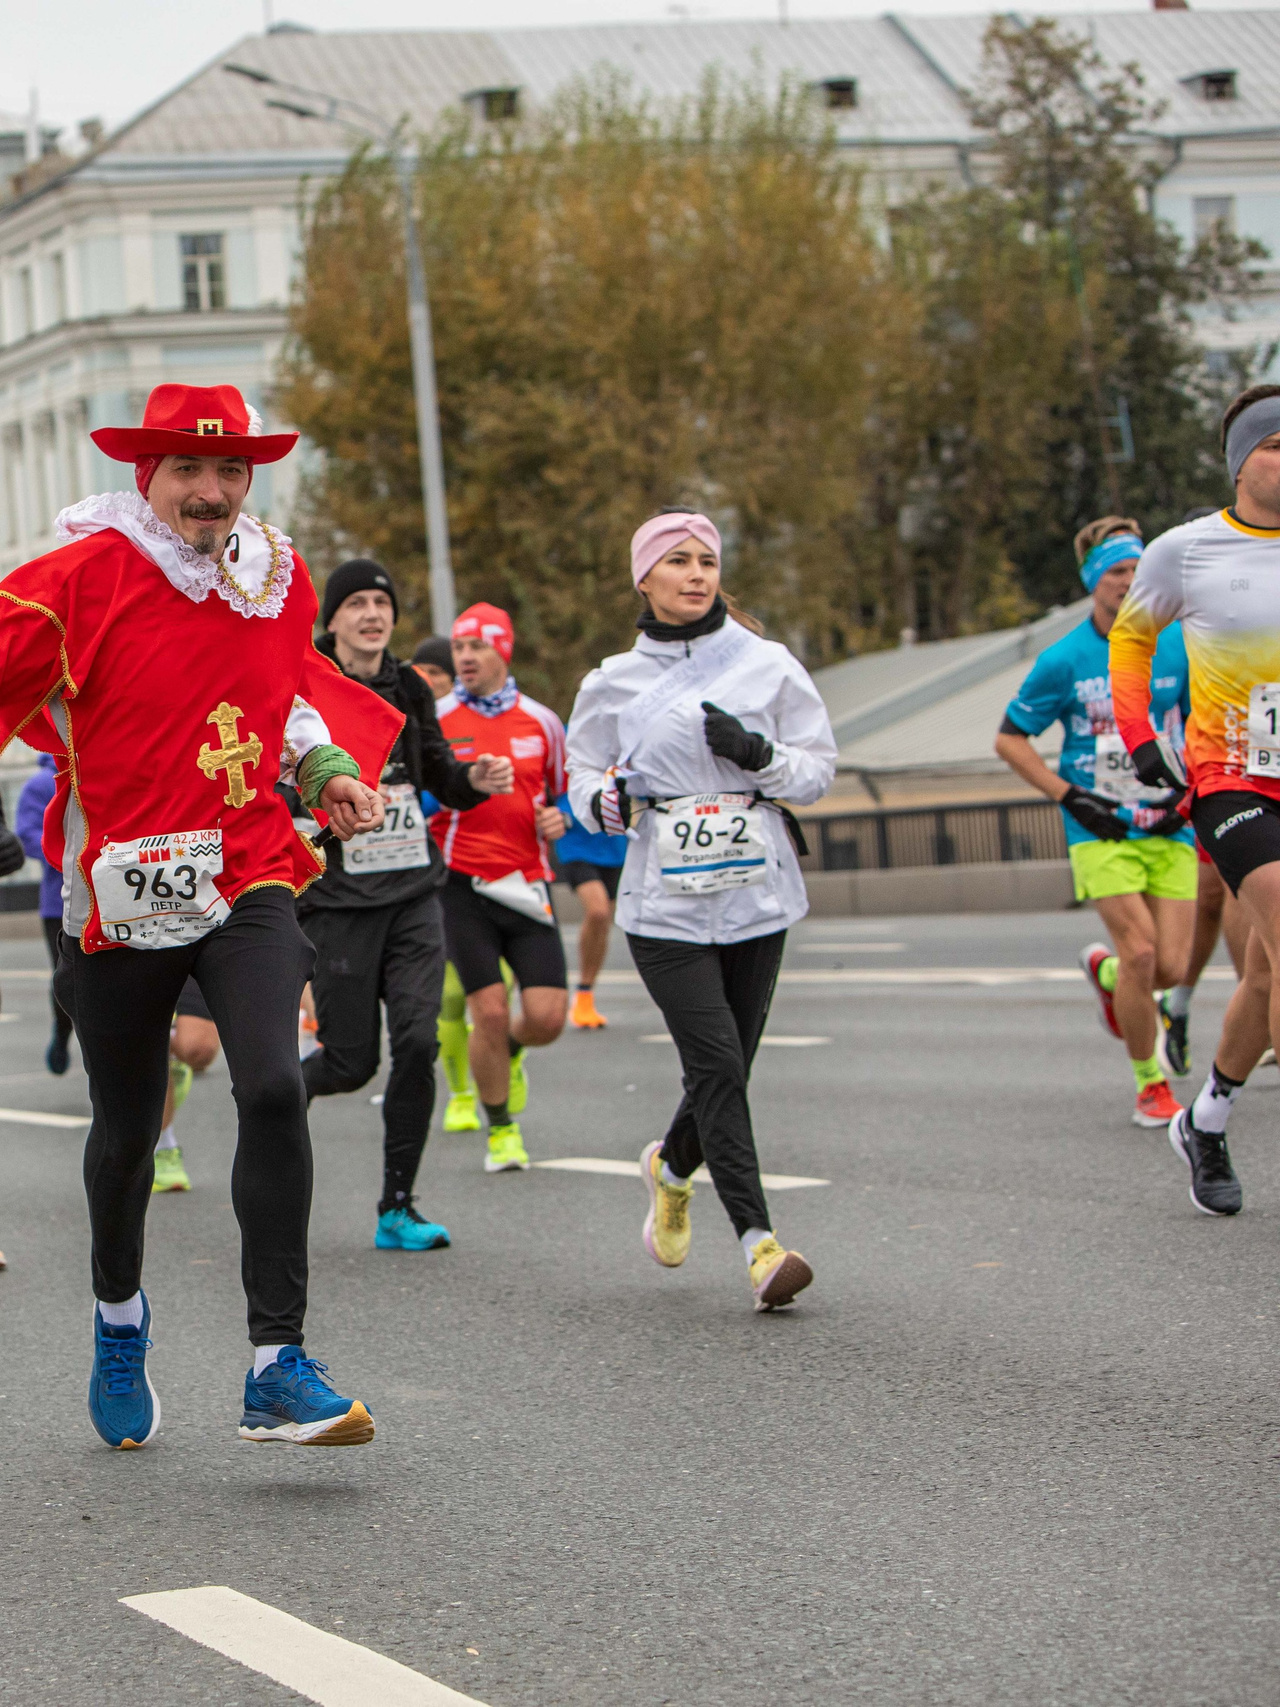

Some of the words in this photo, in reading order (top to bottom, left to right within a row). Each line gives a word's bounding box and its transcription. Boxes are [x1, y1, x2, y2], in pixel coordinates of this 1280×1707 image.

[173, 832, 199, 845] 42,2
[673, 816, 750, 850] 96-2
[681, 853, 723, 863] Organon
[723, 848, 744, 858] RUN
[123, 864, 198, 902] 963
[150, 901, 183, 912] ПЕТР
[113, 923, 132, 942] D
